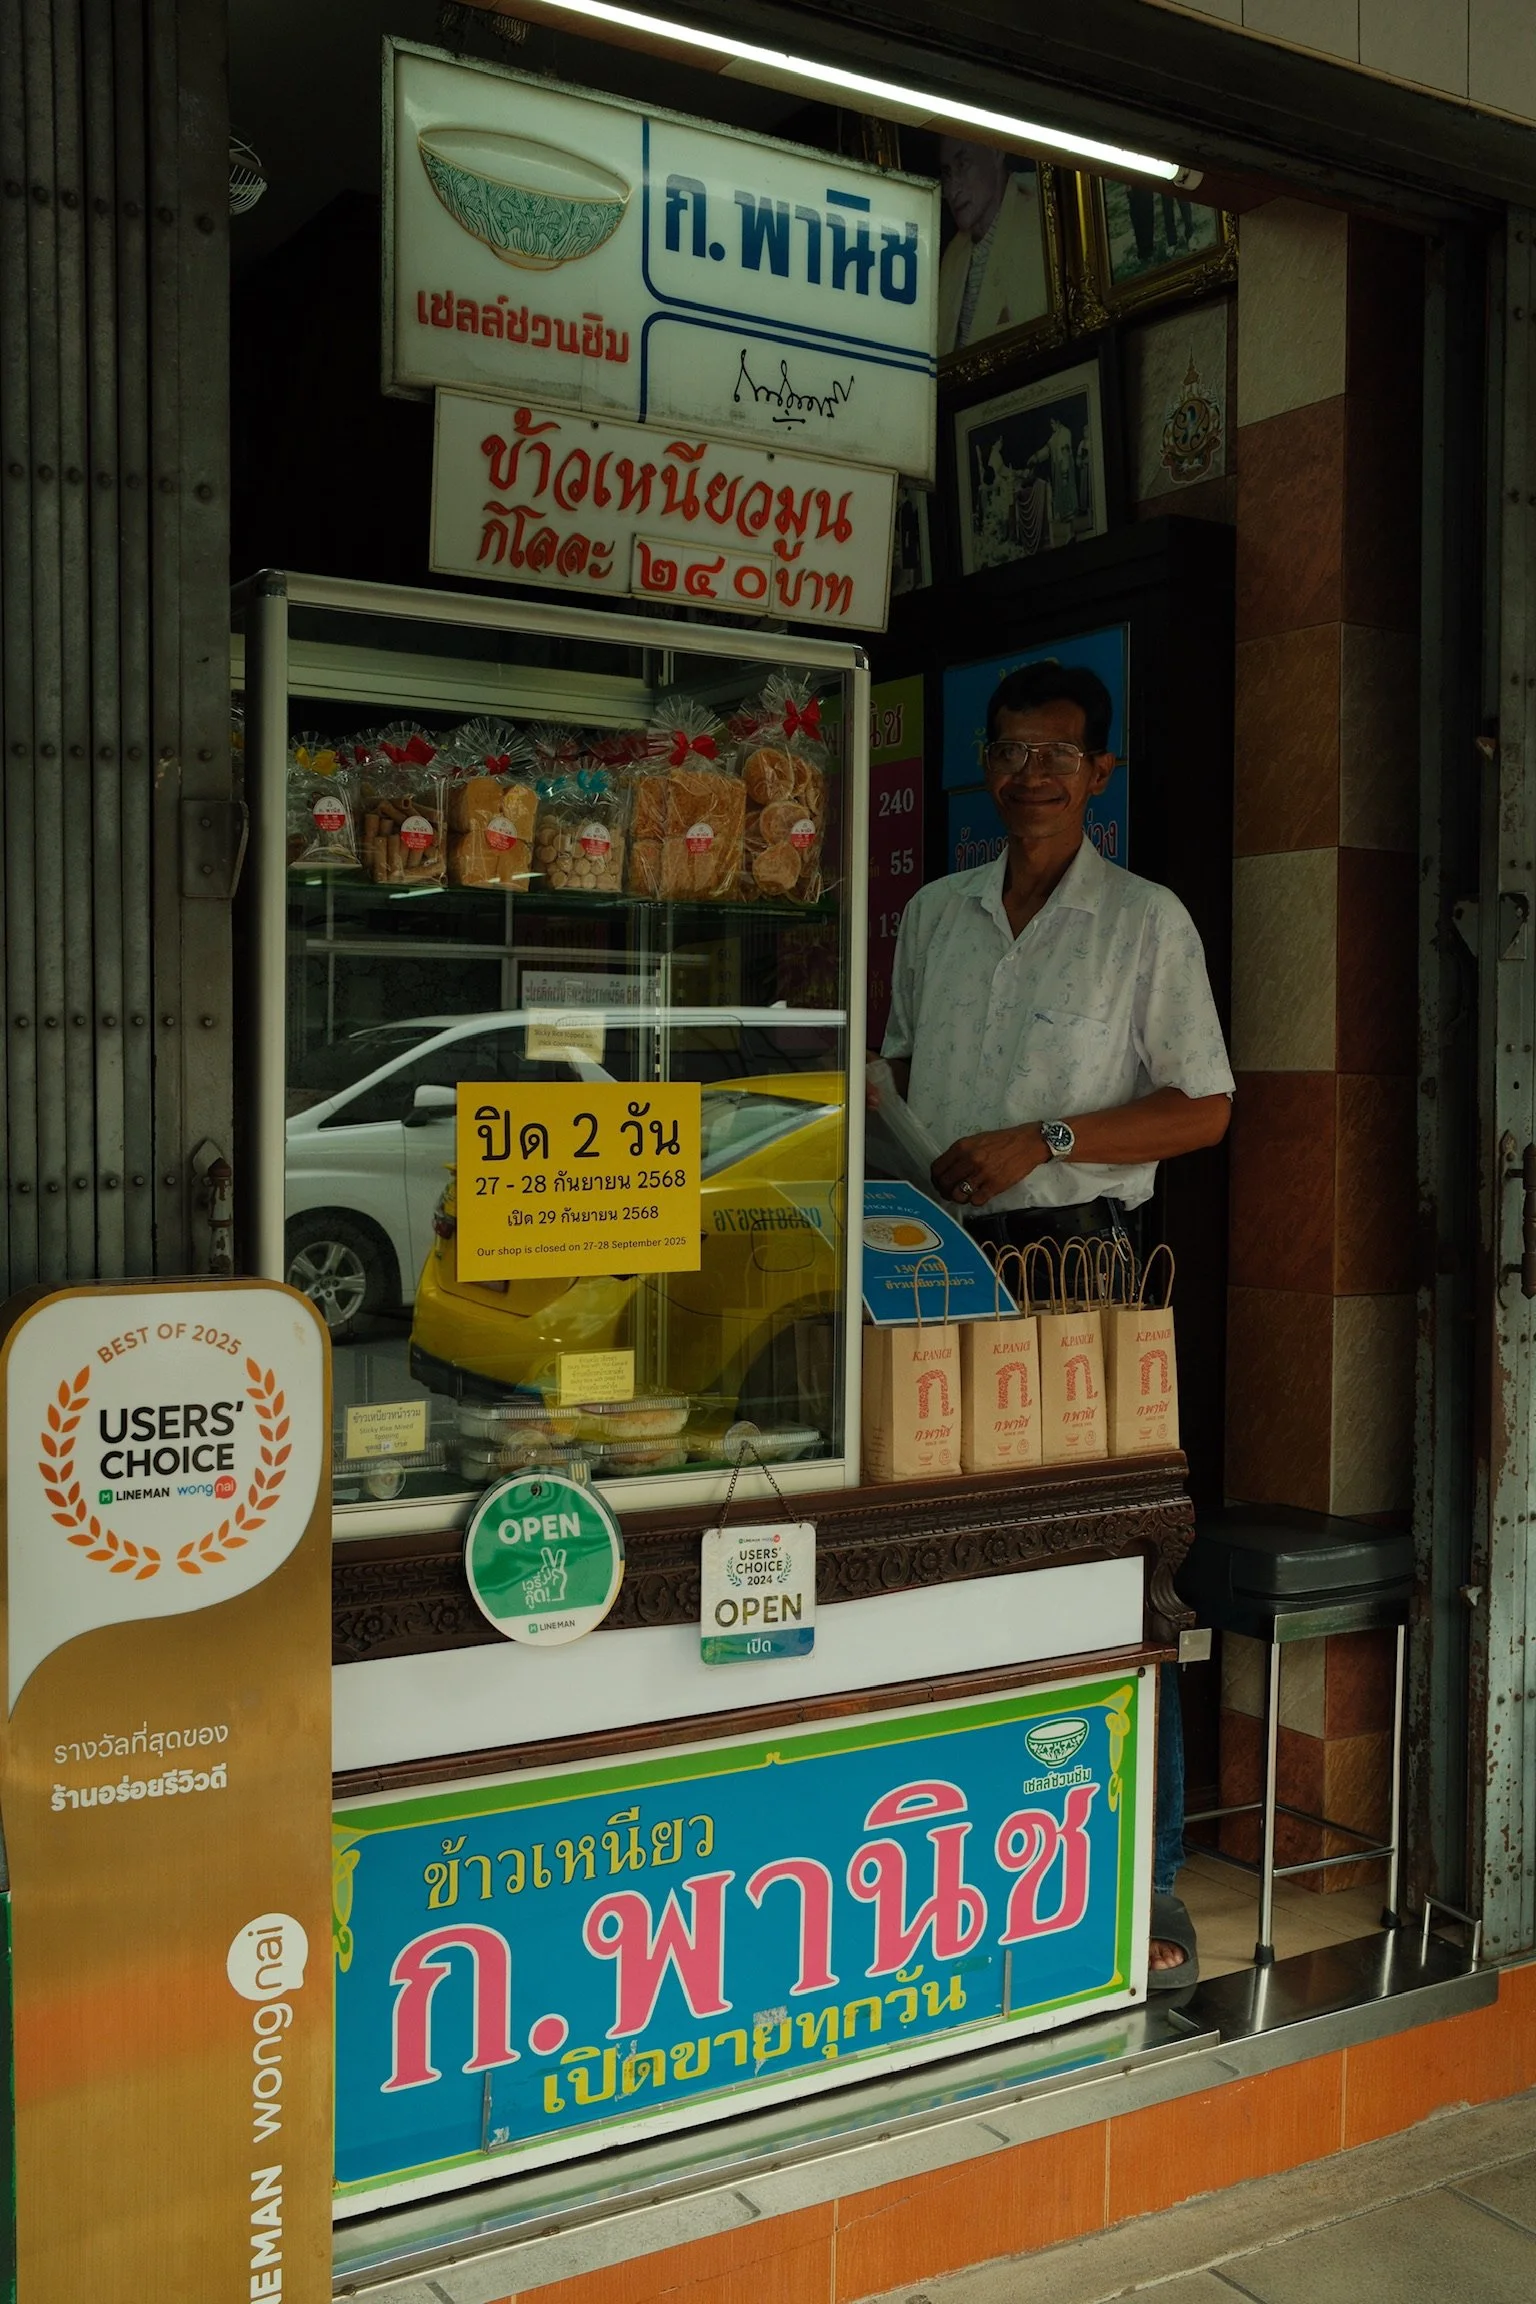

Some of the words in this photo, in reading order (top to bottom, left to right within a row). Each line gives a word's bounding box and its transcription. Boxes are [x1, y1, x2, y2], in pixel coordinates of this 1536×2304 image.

[665, 173, 918, 305] ก.พานิช
[417, 290, 630, 364] เชลล์ชวนชิม
[481, 407, 853, 561] ข้าวเหนียวมูน
[477, 501, 615, 580] กิโลละ
[637, 543, 767, 599] ๒๔๐
[775, 565, 854, 615] บาท
[878, 788, 914, 816] 240
[890, 848, 915, 875] 55
[879, 912, 900, 938] 13
[475, 1105, 549, 1161] ปิด
[573, 1112, 600, 1158] 2
[620, 1101, 681, 1156] วัน
[476, 1177, 500, 1195] 27
[521, 1175, 546, 1194] 28
[554, 1170, 631, 1193] กันยายน
[637, 1169, 686, 1189] 2568
[507, 1209, 533, 1227] เปิด
[538, 1210, 556, 1225] 29
[561, 1206, 617, 1223] กันยายน
[622, 1205, 659, 1220] 2568
[477, 1247, 494, 1257] Our
[498, 1246, 521, 1257] shop
[524, 1244, 532, 1254] is
[535, 1243, 566, 1254] closed
[568, 1243, 580, 1252] on
[583, 1240, 609, 1251] 27-28
[611, 1238, 661, 1251] September
[664, 1237, 686, 1247] 2025
[97, 1326, 150, 1364] BEST
[156, 1322, 187, 1341] OF
[192, 1324, 243, 1356] 2025
[99, 1443, 235, 1480] CHOICE
[498, 1511, 582, 1545] OPEN
[736, 1560, 783, 1574] CHOICE
[747, 1575, 773, 1586] 2024
[715, 1593, 803, 1628] OPEN
[746, 1636, 772, 1656] เปิด
[54, 1718, 229, 1765] รางวัลที่สุดของ
[50, 1763, 227, 1811] ร้านอร่อยรีวิวดี
[1024, 1765, 1091, 1794] เชลล์ชวนชิม
[424, 1806, 715, 1911] ข้าวเหนียว
[380, 1778, 1101, 2094] ก.พานิช
[542, 1964, 967, 2114] เปิดขายทุกวัน
